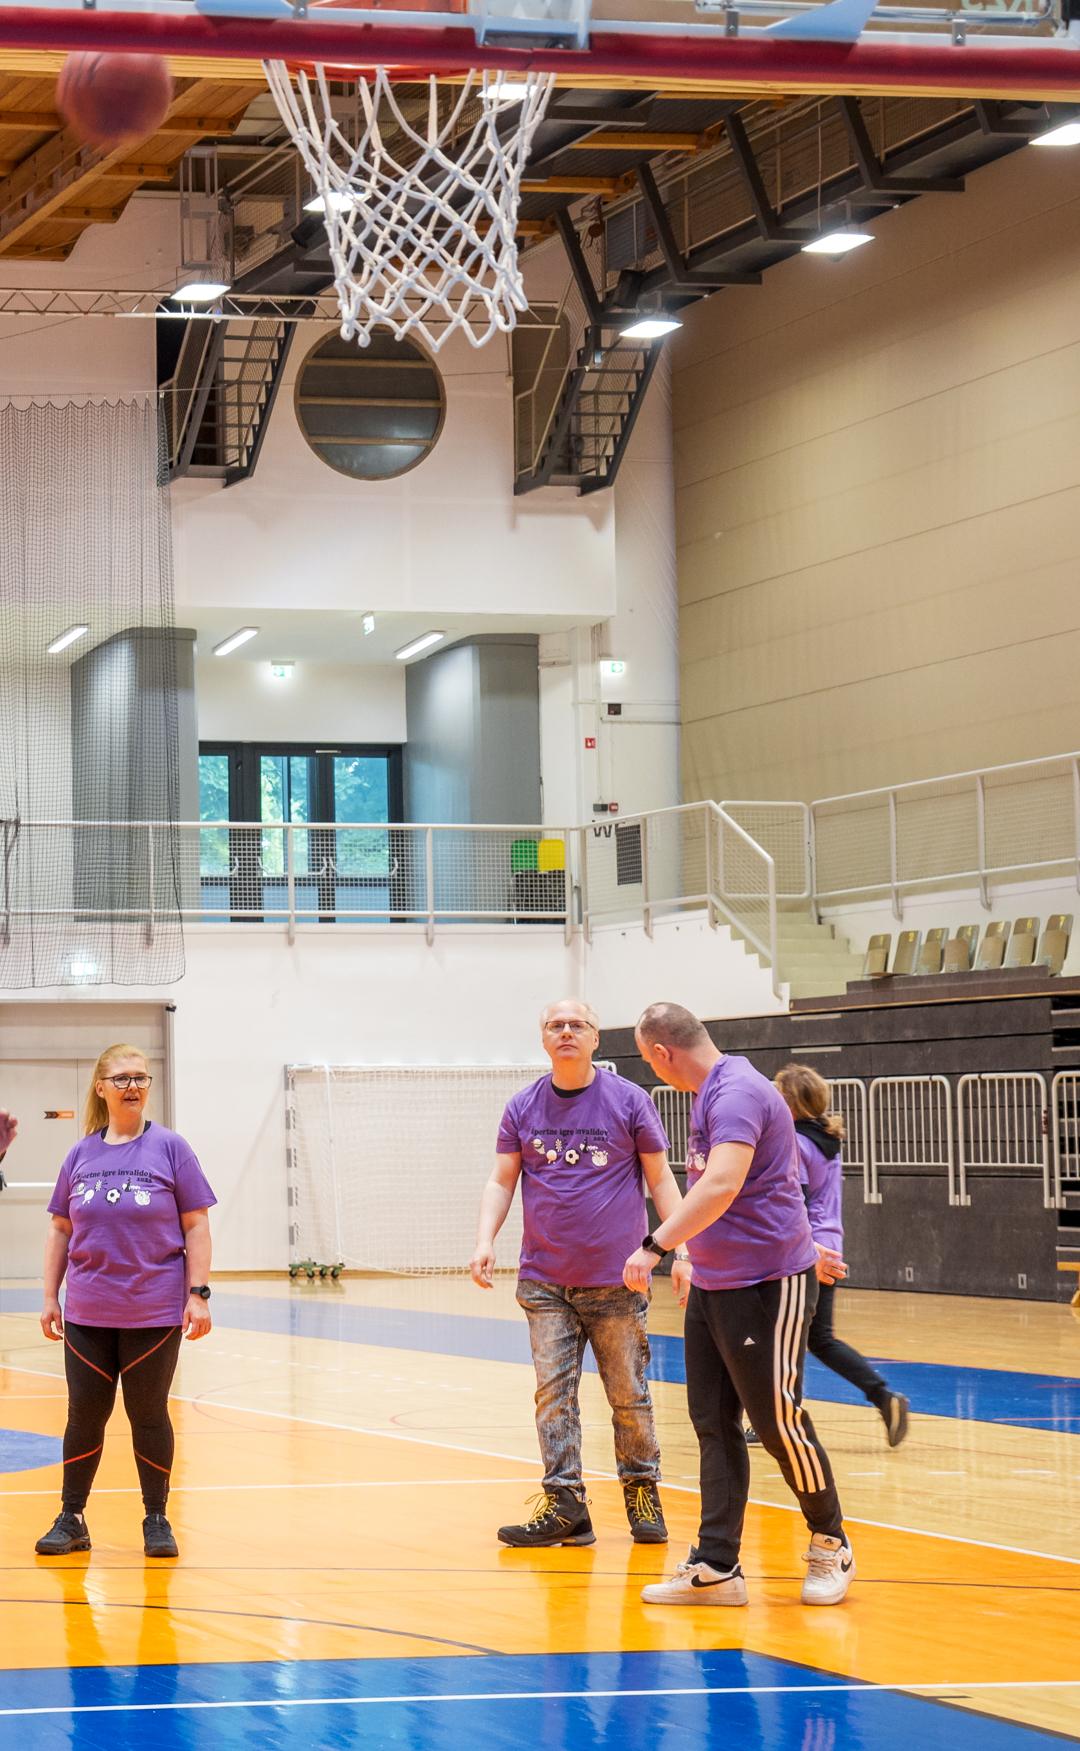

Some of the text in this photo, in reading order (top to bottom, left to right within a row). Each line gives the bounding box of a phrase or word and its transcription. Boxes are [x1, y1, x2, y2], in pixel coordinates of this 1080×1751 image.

[1027, 918, 1033, 929] 6
[1060, 915, 1066, 926] 7
[997, 922, 1004, 933] 5
[880, 935, 884, 945] 1
[908, 932, 914, 942] 2
[559, 1128, 574, 1137] igre
[575, 1127, 608, 1137] invalidov
[102, 1169, 116, 1178] igre
[117, 1168, 154, 1178] invalidov
